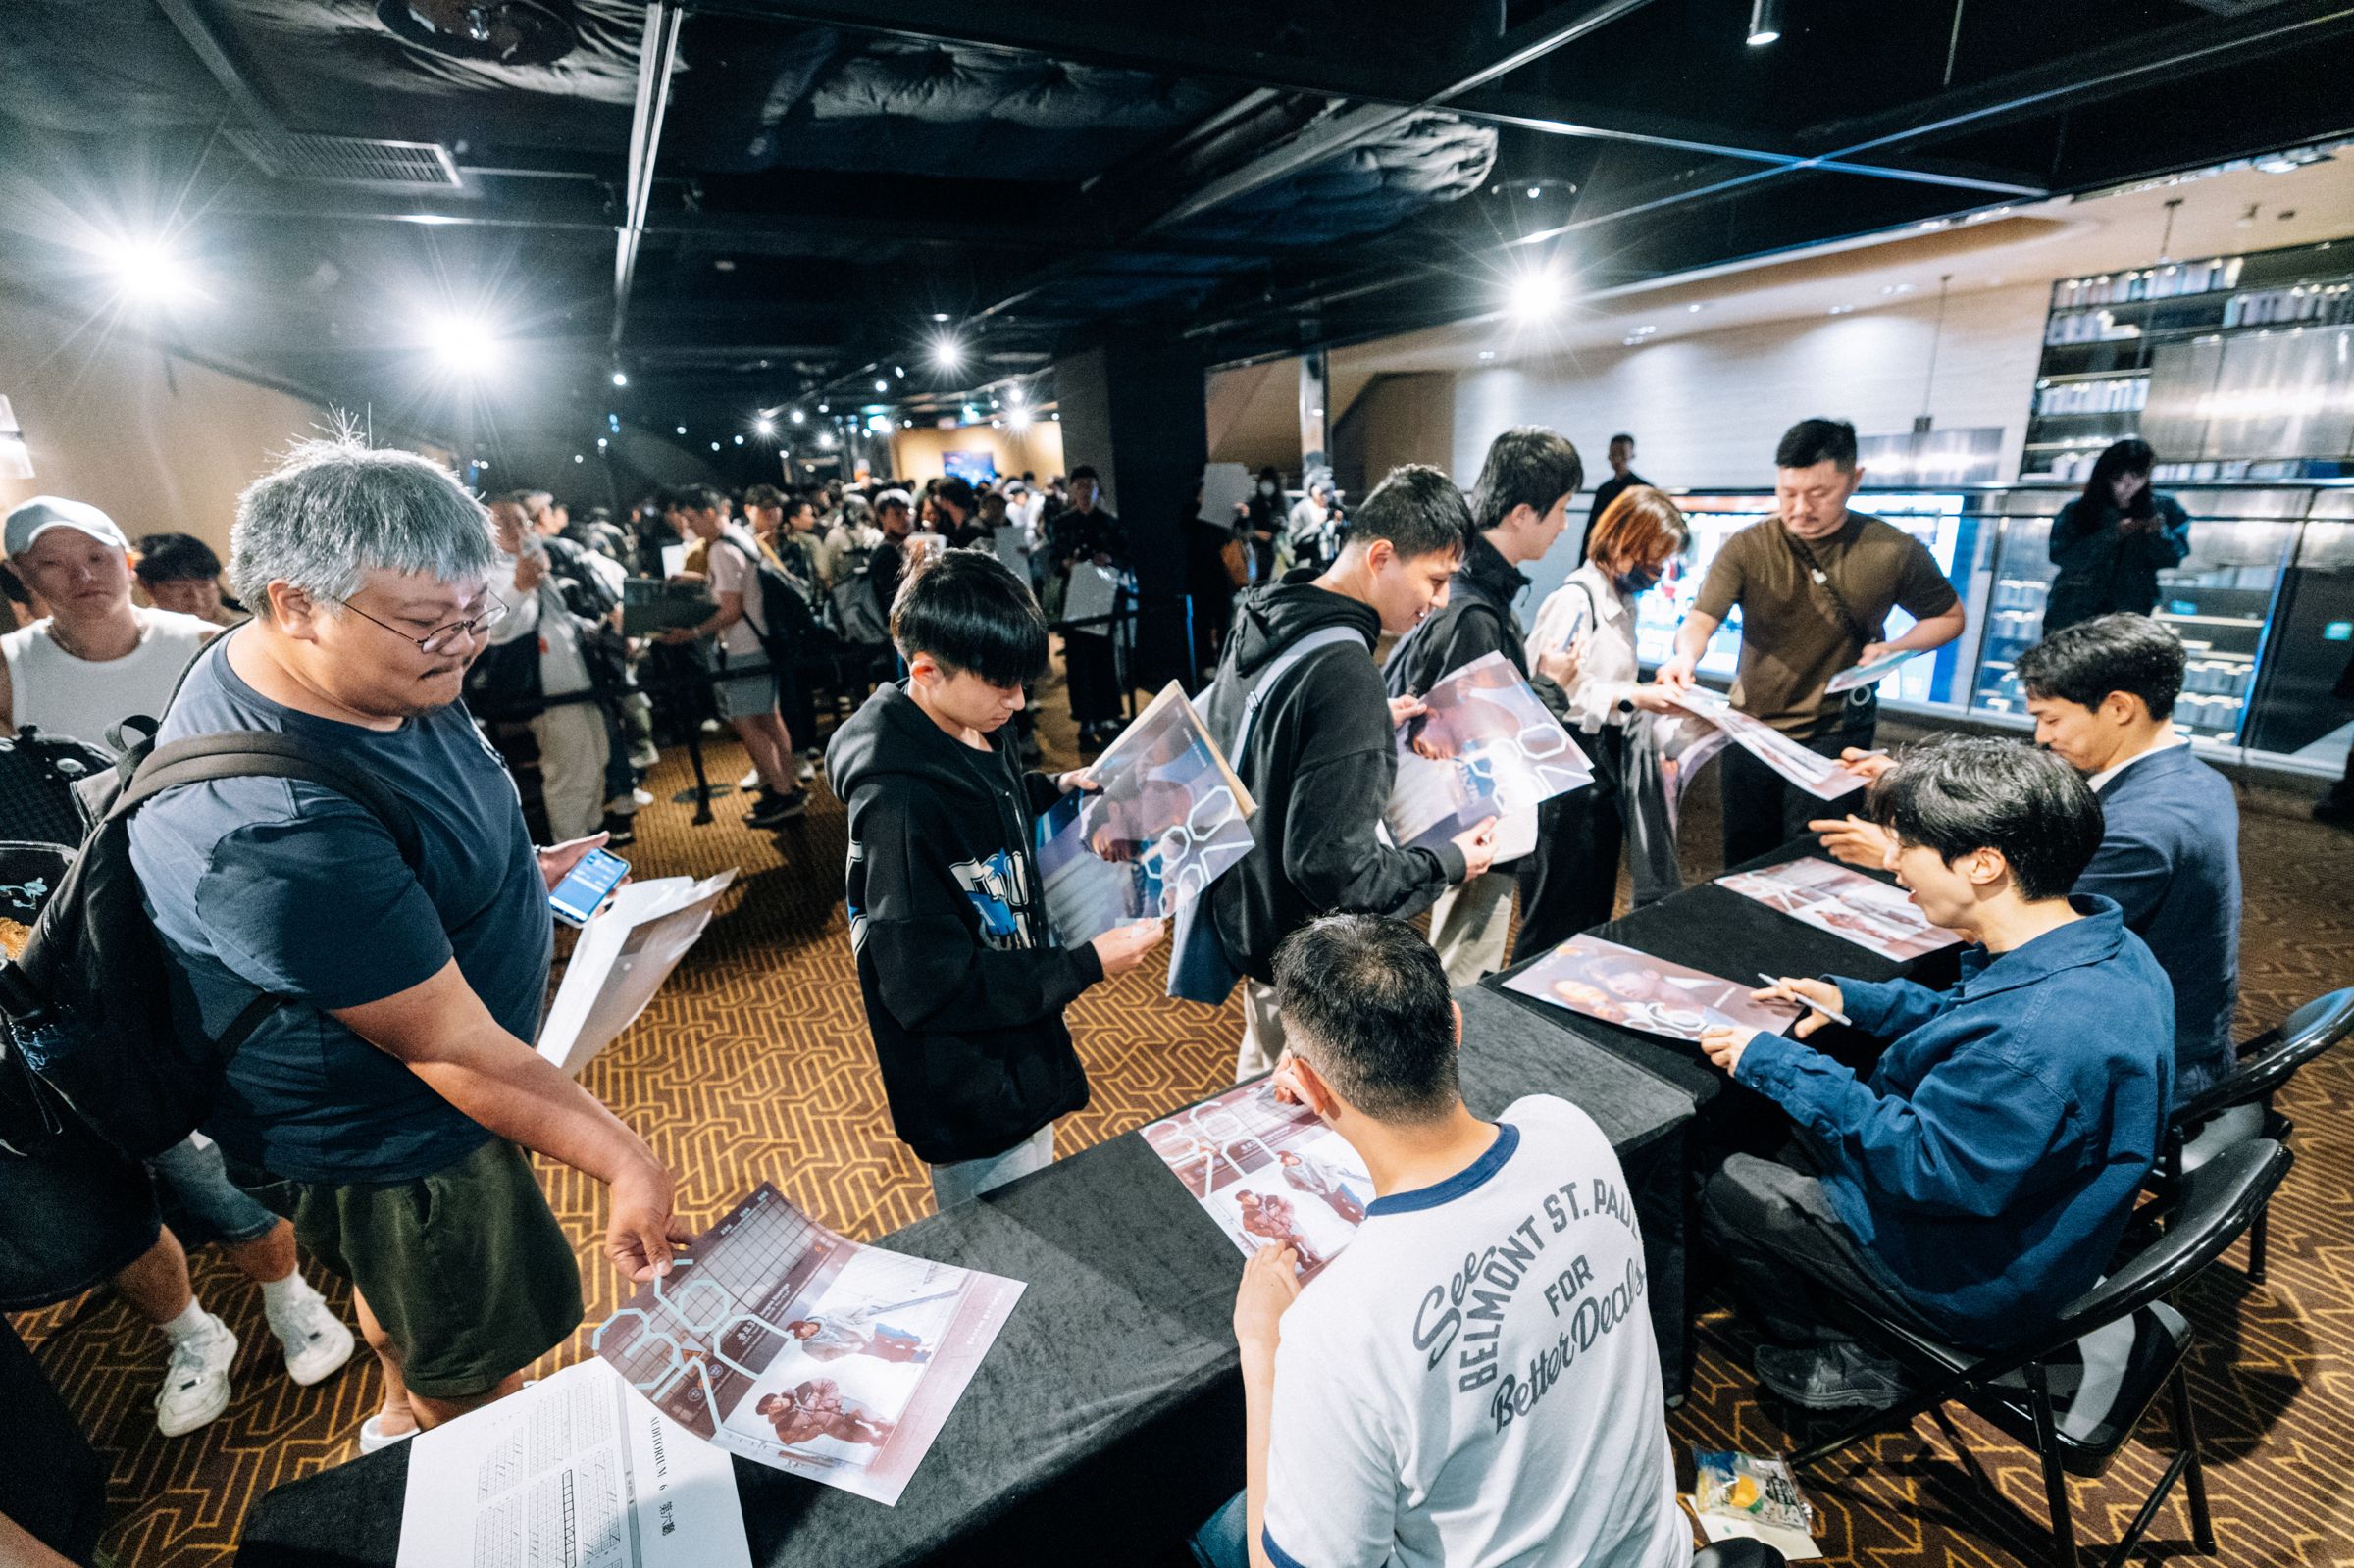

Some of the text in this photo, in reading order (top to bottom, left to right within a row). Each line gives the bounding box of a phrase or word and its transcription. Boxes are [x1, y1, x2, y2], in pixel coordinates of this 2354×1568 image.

[1412, 1245, 1497, 1371] See
[1458, 1215, 1546, 1393] BELMONT
[1543, 1181, 1590, 1234] ST.
[1490, 1257, 1647, 1435] Better Deals
[1543, 1254, 1595, 1318] FOR
[650, 1416, 668, 1479] AUDITORIUM
